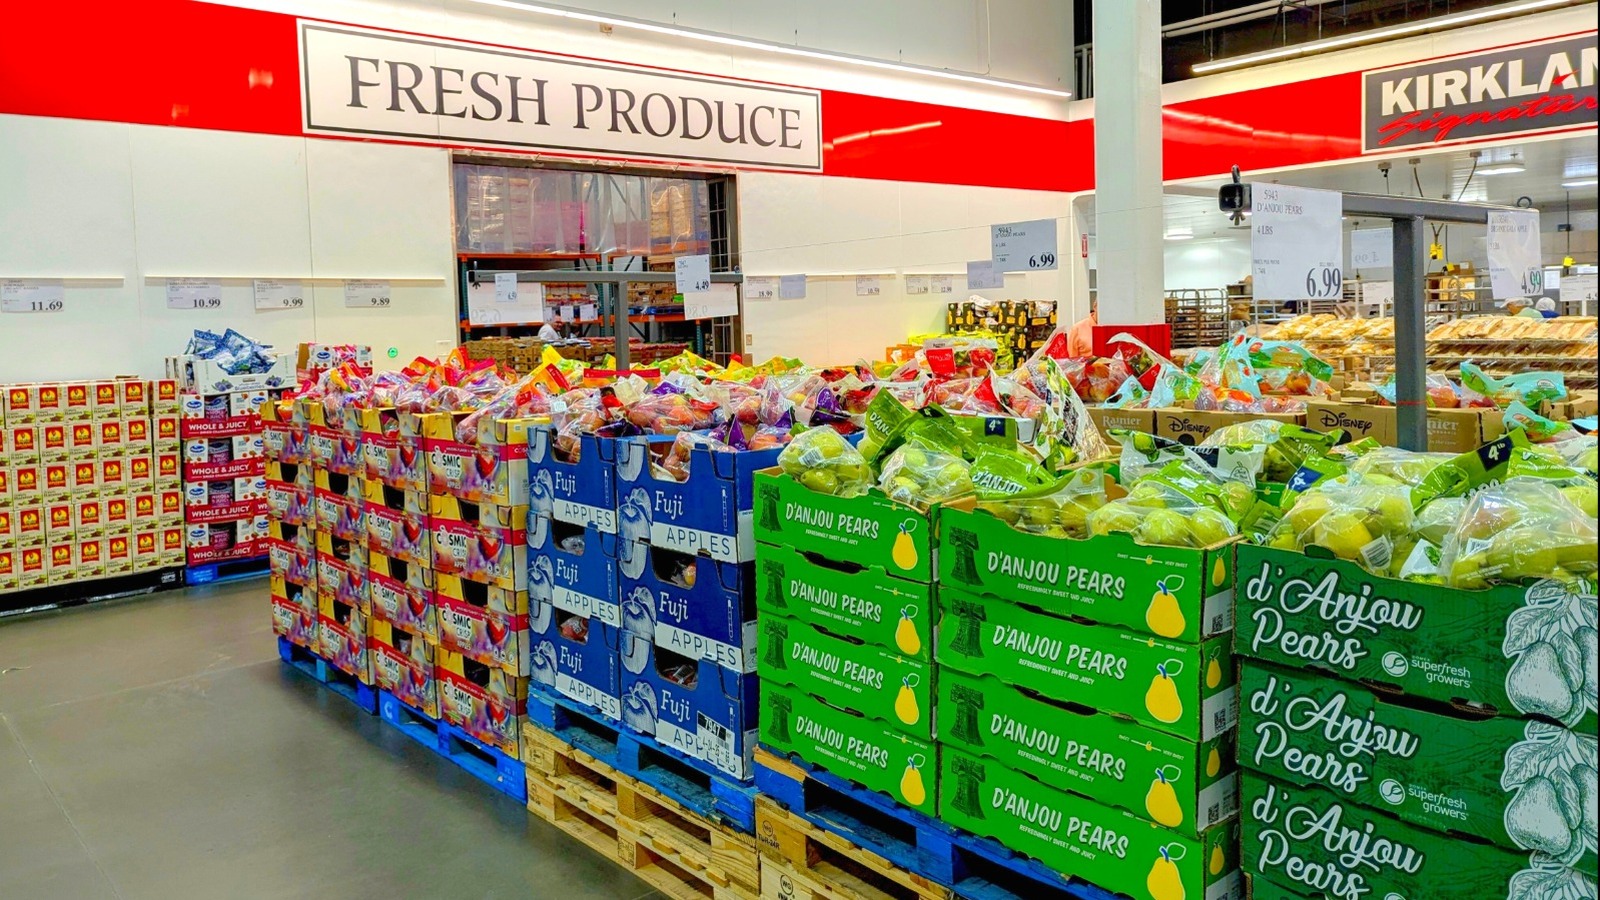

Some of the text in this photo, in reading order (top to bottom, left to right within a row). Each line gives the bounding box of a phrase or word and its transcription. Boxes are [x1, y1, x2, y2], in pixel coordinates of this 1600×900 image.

[344, 55, 803, 149] FRESH PRODUCE
[1264, 190, 1278, 200] 5943
[1285, 205, 1303, 215] PEARS
[1262, 226, 1273, 235] LBS
[1029, 253, 1055, 268] 6.99
[695, 280, 709, 290] 4.49
[1306, 268, 1341, 297] 6.99
[1521, 271, 1542, 294] 4.99
[31, 300, 63, 311] 11.69
[193, 298, 221, 308] 10.99
[283, 298, 303, 307] 9.99
[371, 297, 390, 306] 9.89
[225, 420, 247, 429] JUICY
[1103, 415, 1142, 427] Rainier
[1426, 419, 1459, 435] nier
[228, 464, 249, 472] JUICY
[555, 471, 577, 497] Fuji
[229, 506, 250, 514] JUICY
[565, 502, 612, 527] APPLES
[655, 490, 684, 520] Fuji
[786, 502, 880, 540] D'ANJOU PEARS
[667, 527, 730, 555] APPLES
[556, 558, 579, 586] Fuji
[988, 550, 1126, 600] D'ANJOU PEARS
[565, 591, 615, 621] APPLES
[659, 591, 689, 624] Fuji
[790, 580, 882, 623] D'ANJOU PEARS
[1017, 583, 1051, 595] REFRESHINGLY
[1051, 587, 1070, 598] SWEET
[1081, 595, 1095, 604] JUICY
[1246, 563, 1424, 634] d'Anjou
[671, 629, 737, 664] APPLES
[1253, 607, 1367, 669] Pears
[560, 646, 583, 673] Fuji
[792, 642, 884, 690] D'ANJOU PEARS
[992, 625, 1128, 681] D'ANJOU PEARS
[1018, 659, 1095, 685] REFRESHINGLY SWEET AND JUICY
[1411, 659, 1471, 678] superfresh
[1426, 672, 1471, 688] growers
[569, 679, 616, 715] APPLES
[661, 690, 690, 721] Fuji
[704, 717, 721, 737] 7947
[1251, 677, 1418, 757] d'Anjou
[796, 716, 889, 769] D'ANJOU PEARS
[991, 714, 1126, 781] D'ANJOU PEARS
[1017, 750, 1095, 783] REFRESHINGLY SWEET AND JUICY
[1255, 721, 1369, 793] Pears
[1408, 786, 1467, 810] superfresh
[1423, 800, 1468, 821] growers
[992, 788, 1129, 860] D'ANJOU PEARS
[1252, 784, 1424, 873] d'Anjou
[1019, 824, 1096, 861] REFRESHINGLY SWEET AND JUICY
[1258, 829, 1370, 900] Pears
